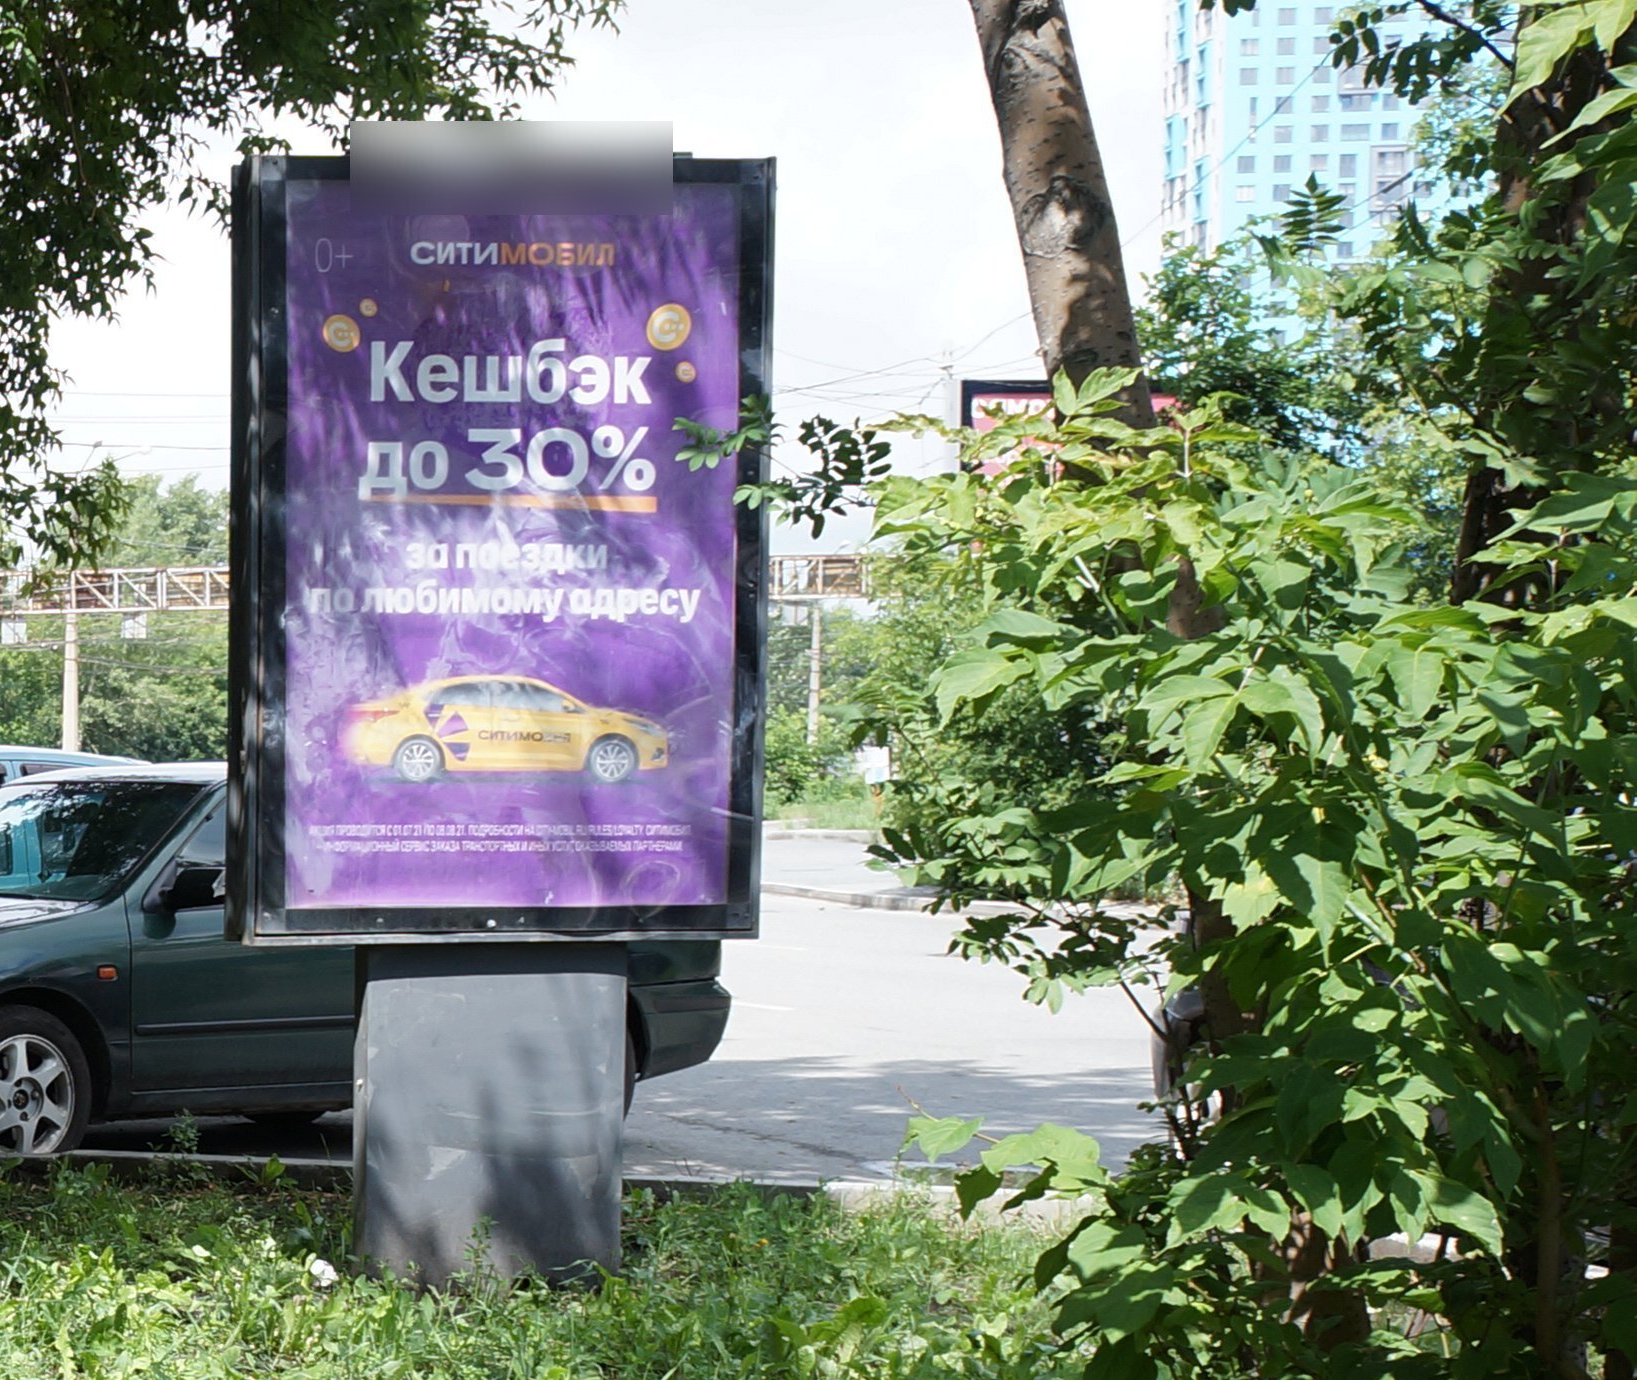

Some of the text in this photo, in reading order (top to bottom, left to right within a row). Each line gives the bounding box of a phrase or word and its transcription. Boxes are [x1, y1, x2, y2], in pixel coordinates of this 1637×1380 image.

[315, 238, 353, 272] 0+
[410, 241, 615, 267] СИТИМОБИЛ
[370, 338, 652, 404] Кешбэк
[358, 424, 656, 500] до 30%
[406, 543, 608, 574] за поездки
[309, 579, 701, 623] по любимому адресу
